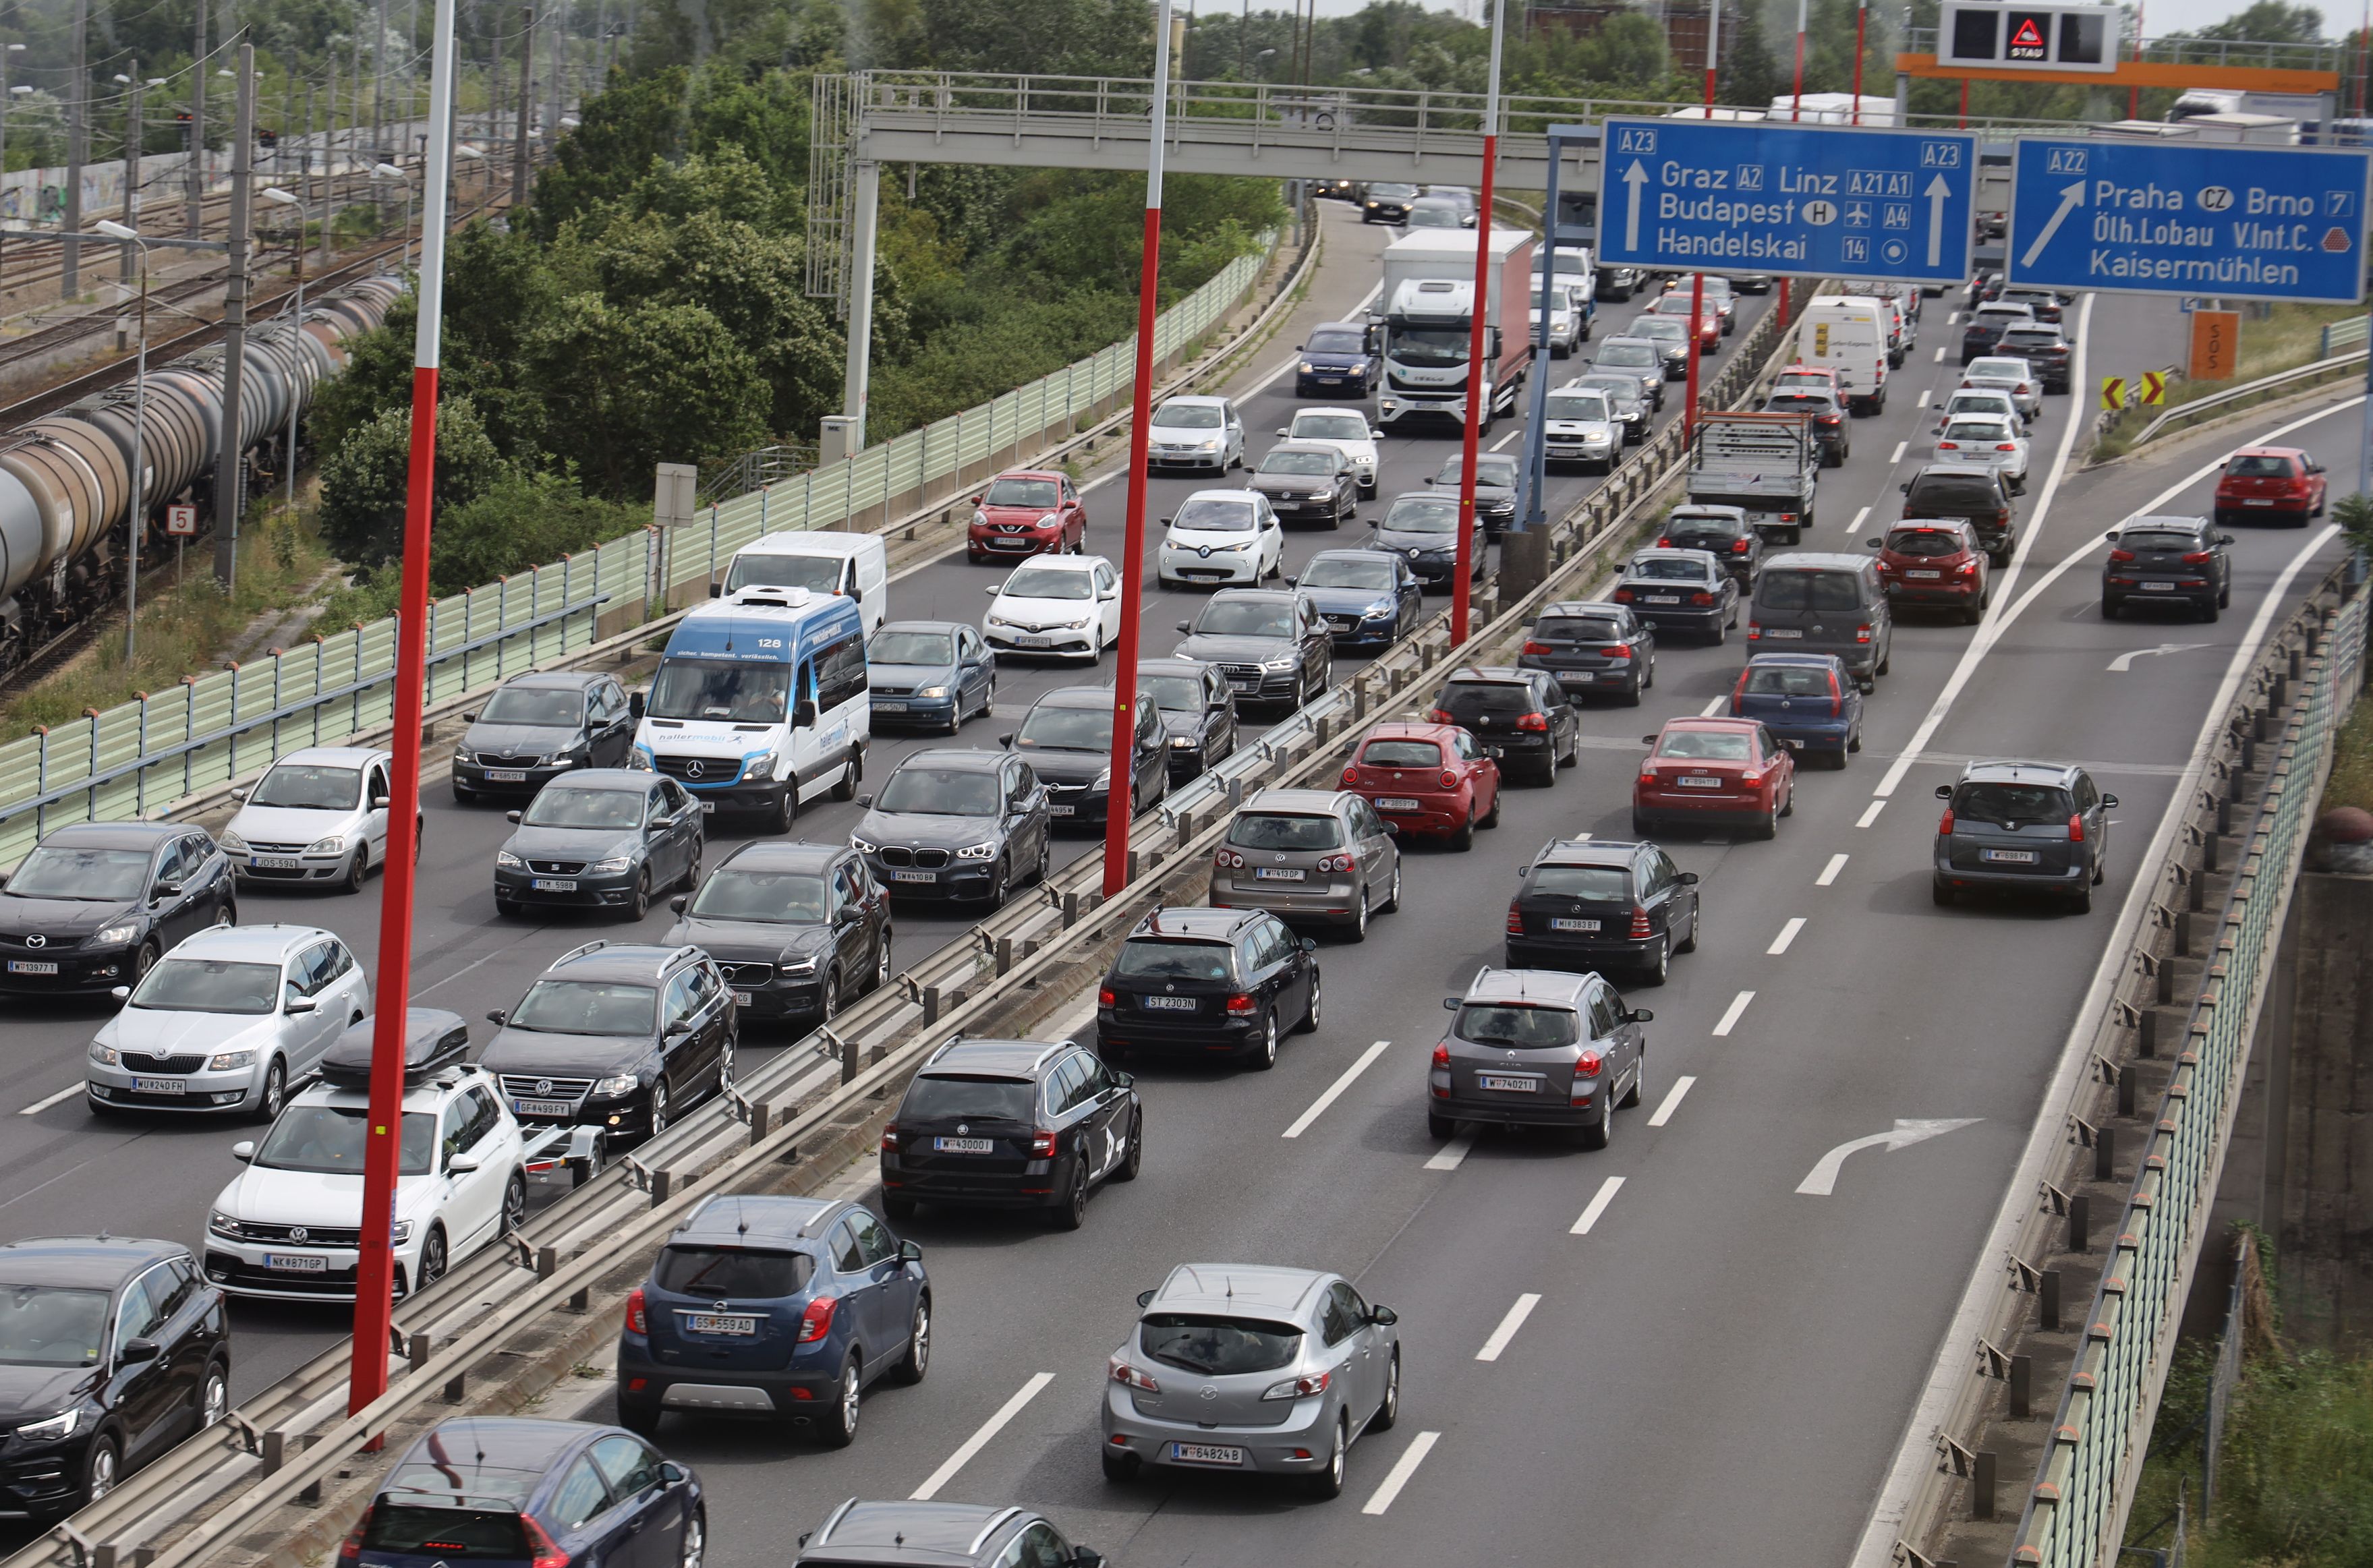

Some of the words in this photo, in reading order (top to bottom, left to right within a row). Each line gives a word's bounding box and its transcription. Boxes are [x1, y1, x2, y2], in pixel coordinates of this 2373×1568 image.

[2011, 48, 2043, 58] STAU
[1621, 131, 1655, 152] A23
[1924, 144, 1958, 165] A23
[2050, 150, 2085, 172] A22
[1661, 161, 1728, 189] Graz
[1738, 167, 1761, 188] A2
[1779, 167, 1838, 194] Linz
[1850, 173, 1883, 194] A21
[1887, 175, 1908, 195] A1
[2095, 180, 2183, 210] Praha
[2205, 189, 2227, 208] CZ
[2247, 187, 2314, 216] Brno
[2333, 194, 2347, 214] 7
[1659, 193, 1795, 229] Budapest
[1812, 203, 1827, 222] H
[1885, 206, 1908, 227] A4
[2094, 211, 2214, 247] Ölh.Lobau
[2234, 221, 2314, 252] V.Int.C.
[1658, 227, 1806, 260] Handelskai
[1846, 239, 1864, 260] 14
[2090, 249, 2299, 285] Kaisermühlen
[2208, 324, 2221, 369] SOS
[176, 511, 187, 529] 5
[757, 639, 782, 648] 128
[658, 734, 726, 742] hallermobil
[258, 859, 293, 868] JDS-594
[538, 881, 550, 889] 1TM
[556, 881, 573, 890] 5988
[738, 994, 748, 1002] CG
[1151, 997, 1162, 1006] ST
[1166, 999, 1194, 1008] 2303N
[138, 1080, 148, 1088] WU
[155, 1081, 170, 1090] 240
[172, 1082, 182, 1091] FH
[521, 1103, 530, 1111] GF
[538, 1105, 552, 1113] 499
[554, 1105, 566, 1114] FY
[943, 1139, 949, 1147] W
[273, 1258, 284, 1266] NK
[696, 1317, 709, 1327] GS
[717, 1318, 735, 1329] 559
[739, 1320, 751, 1331] AD
[1180, 1447, 1188, 1456] W
[1197, 1448, 1230, 1459] 64824
